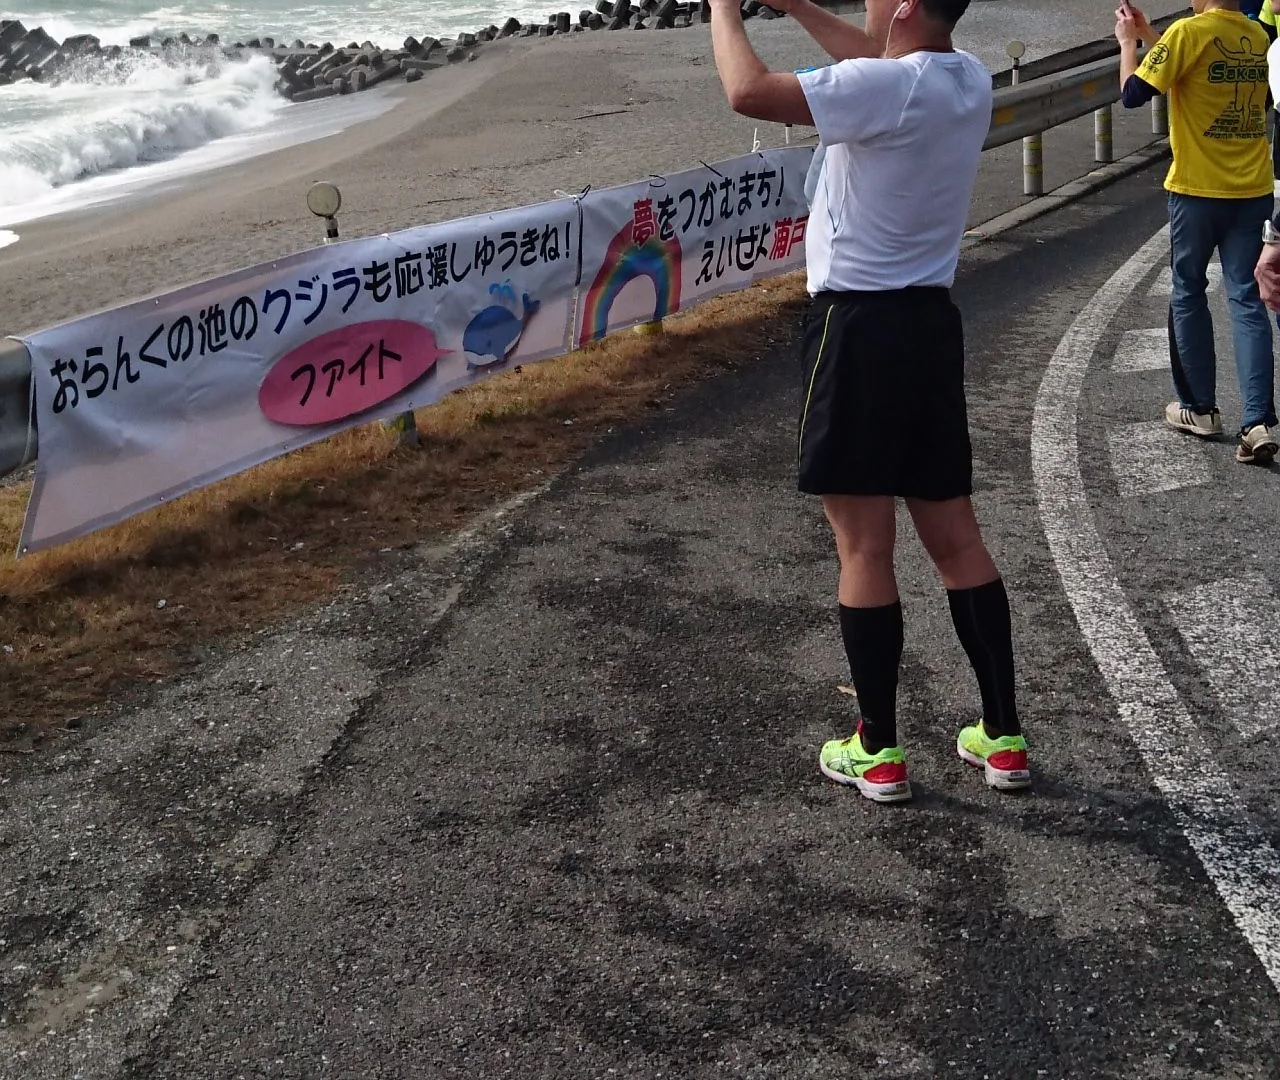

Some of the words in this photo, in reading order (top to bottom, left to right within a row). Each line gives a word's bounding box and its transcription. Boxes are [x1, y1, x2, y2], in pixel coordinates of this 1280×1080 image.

[632, 166, 785, 248] 夢をつかむまち！
[695, 214, 810, 286] えいぜよ浦戸
[51, 221, 574, 415] おらんくの池のクジラも応援しゆうきね！
[291, 339, 403, 407] ファイト
